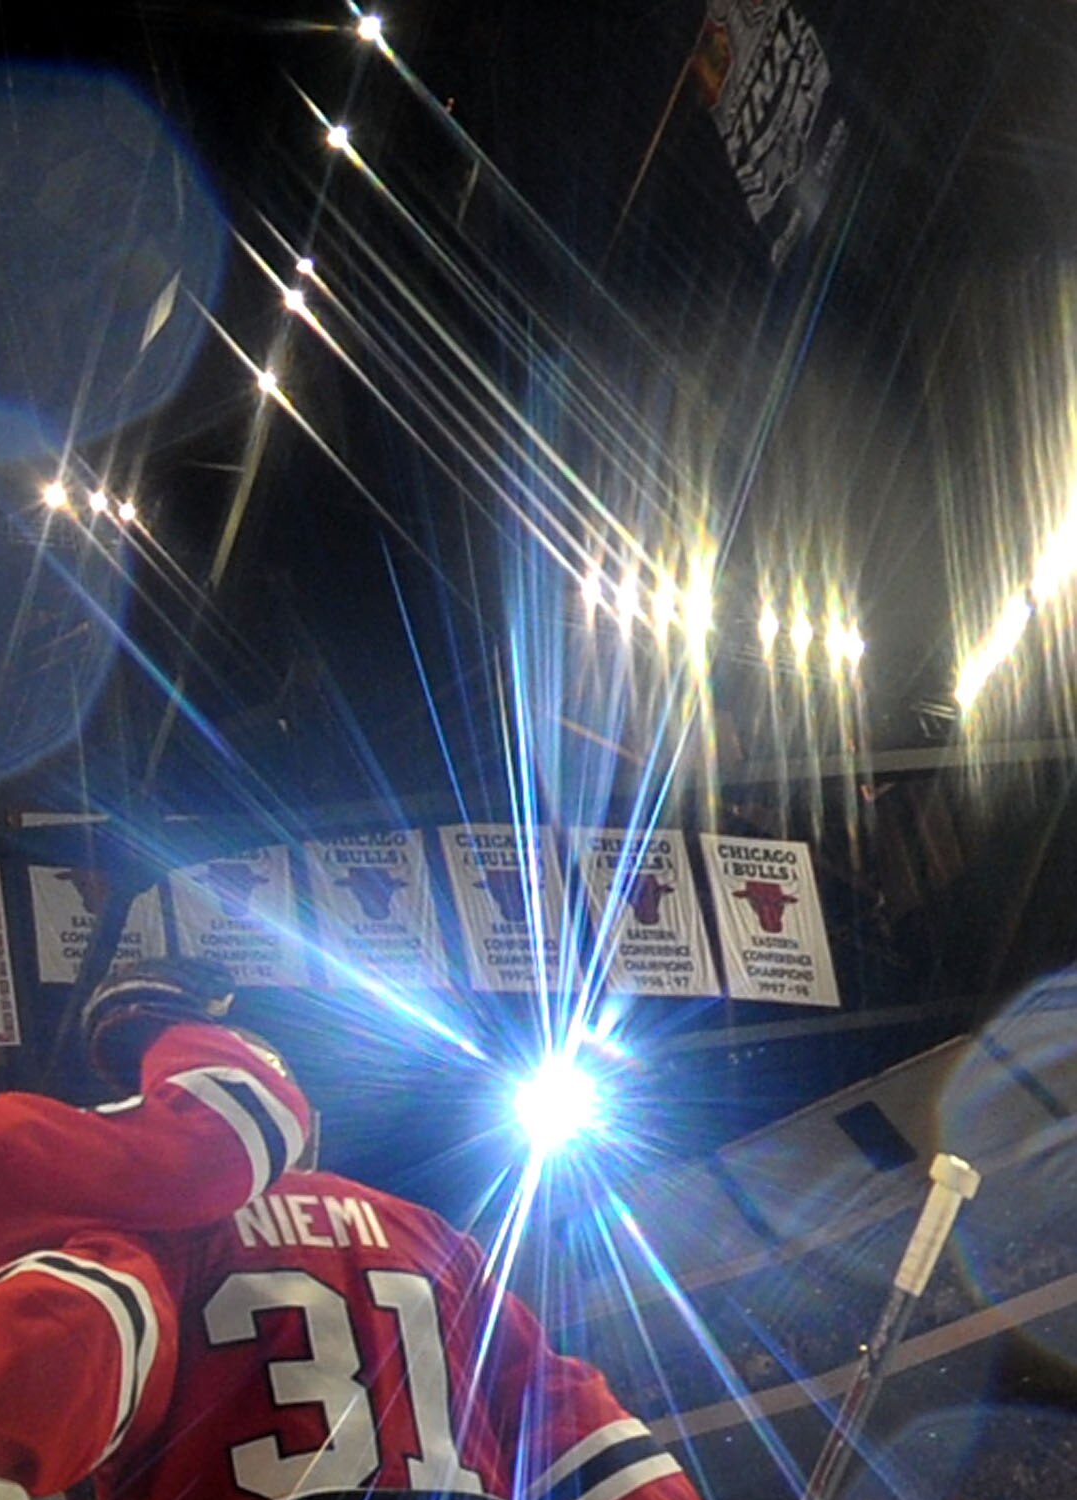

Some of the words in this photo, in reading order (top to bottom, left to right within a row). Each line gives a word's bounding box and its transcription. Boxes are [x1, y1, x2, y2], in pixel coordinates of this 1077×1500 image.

[717, 843, 797, 865] CHICAGO
[733, 861, 790, 881] BULLS
[234, 1194, 391, 1250] NIEMI
[203, 1268, 489, 1500] 31
